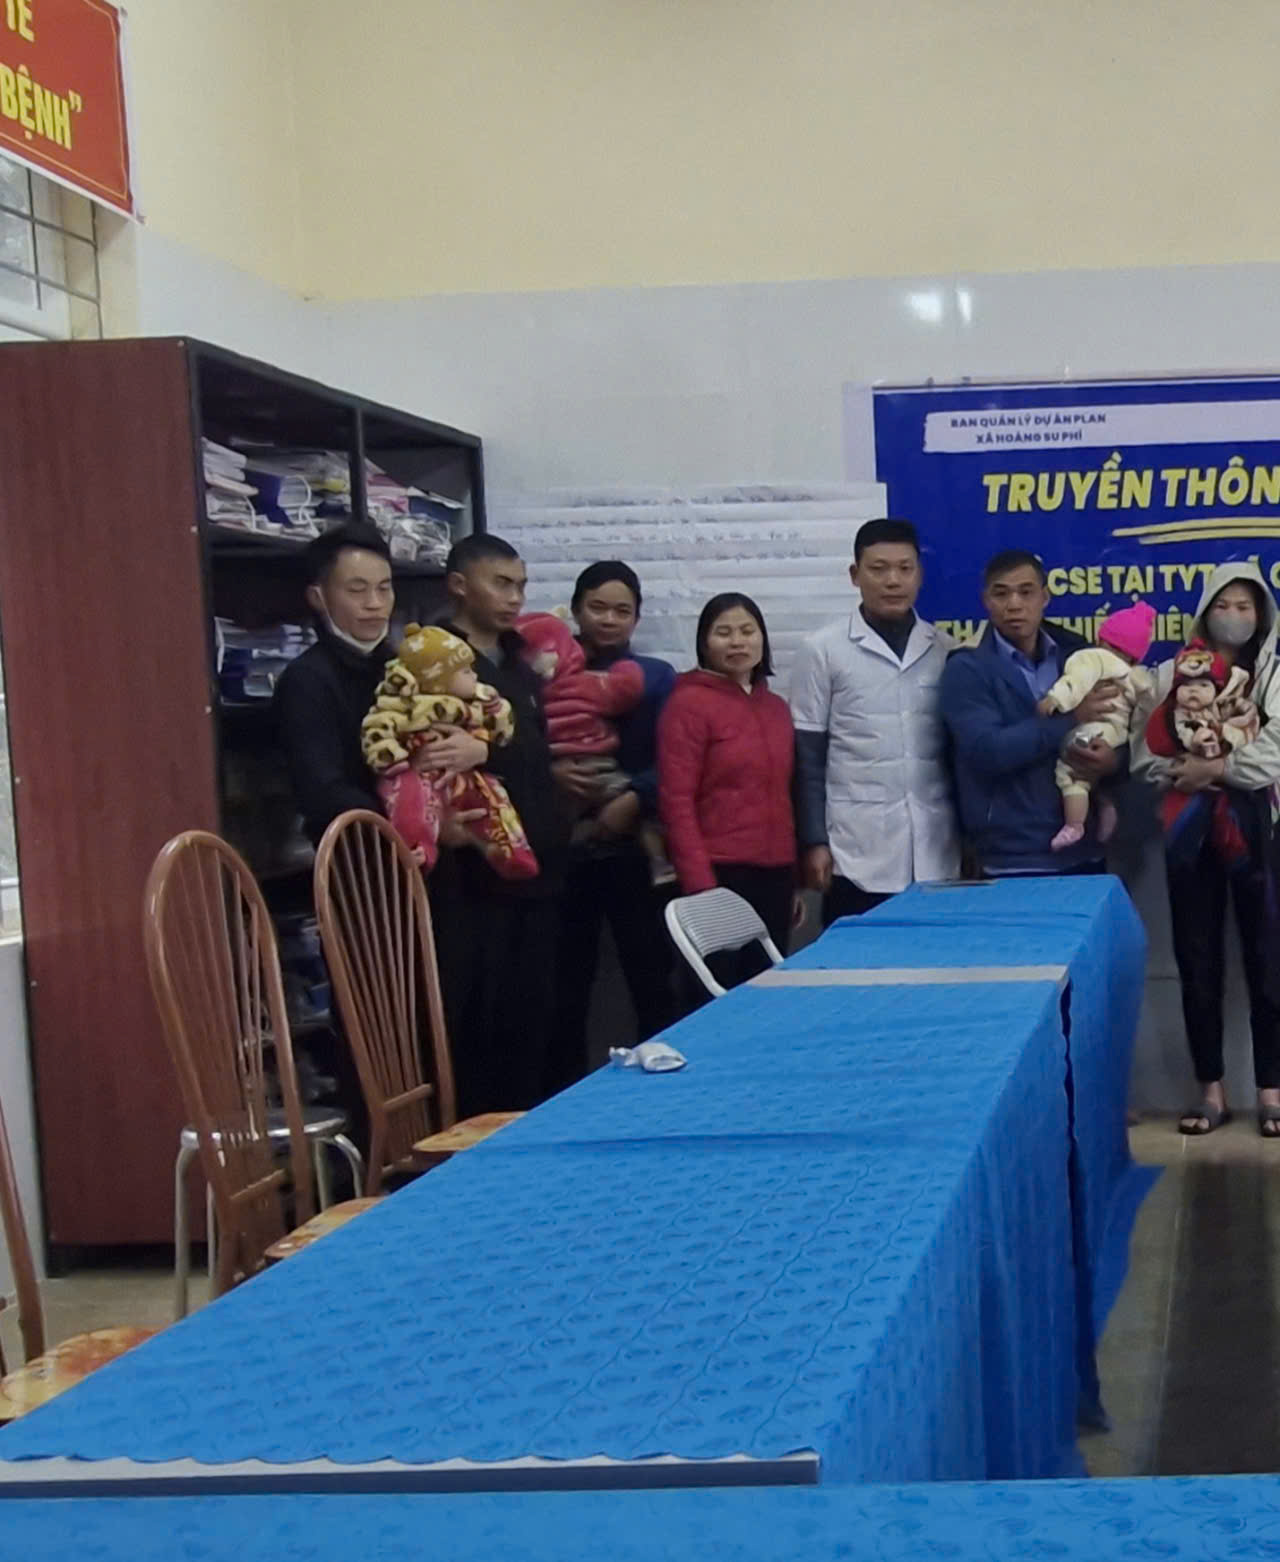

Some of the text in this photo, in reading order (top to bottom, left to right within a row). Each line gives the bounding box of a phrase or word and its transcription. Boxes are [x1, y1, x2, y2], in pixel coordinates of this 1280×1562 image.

[951, 418, 978, 428] BAN
[1074, 413, 1106, 424] PLAN
[1044, 431, 1060, 442] SU
[982, 451, 1154, 514] TRUYỀN
[1048, 566, 1103, 596] CSE
[1106, 564, 1155, 602] TẠI
